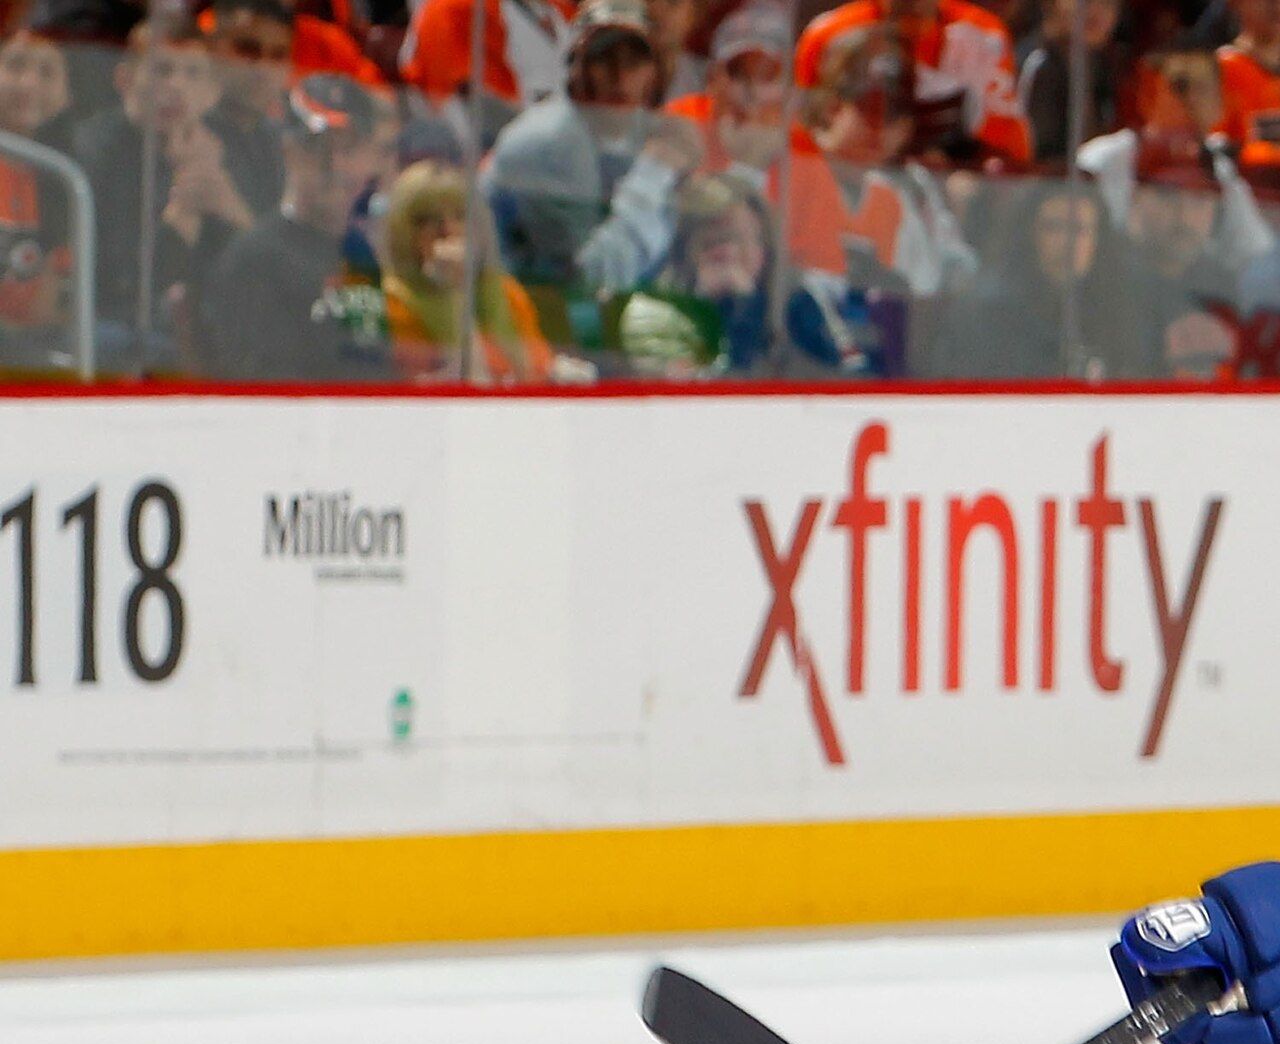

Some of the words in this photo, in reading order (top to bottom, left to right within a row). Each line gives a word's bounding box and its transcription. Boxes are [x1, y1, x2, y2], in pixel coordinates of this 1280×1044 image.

[0, 478, 186, 684] 118
[262, 493, 404, 556] Million
[738, 419, 1227, 768] xfinity
